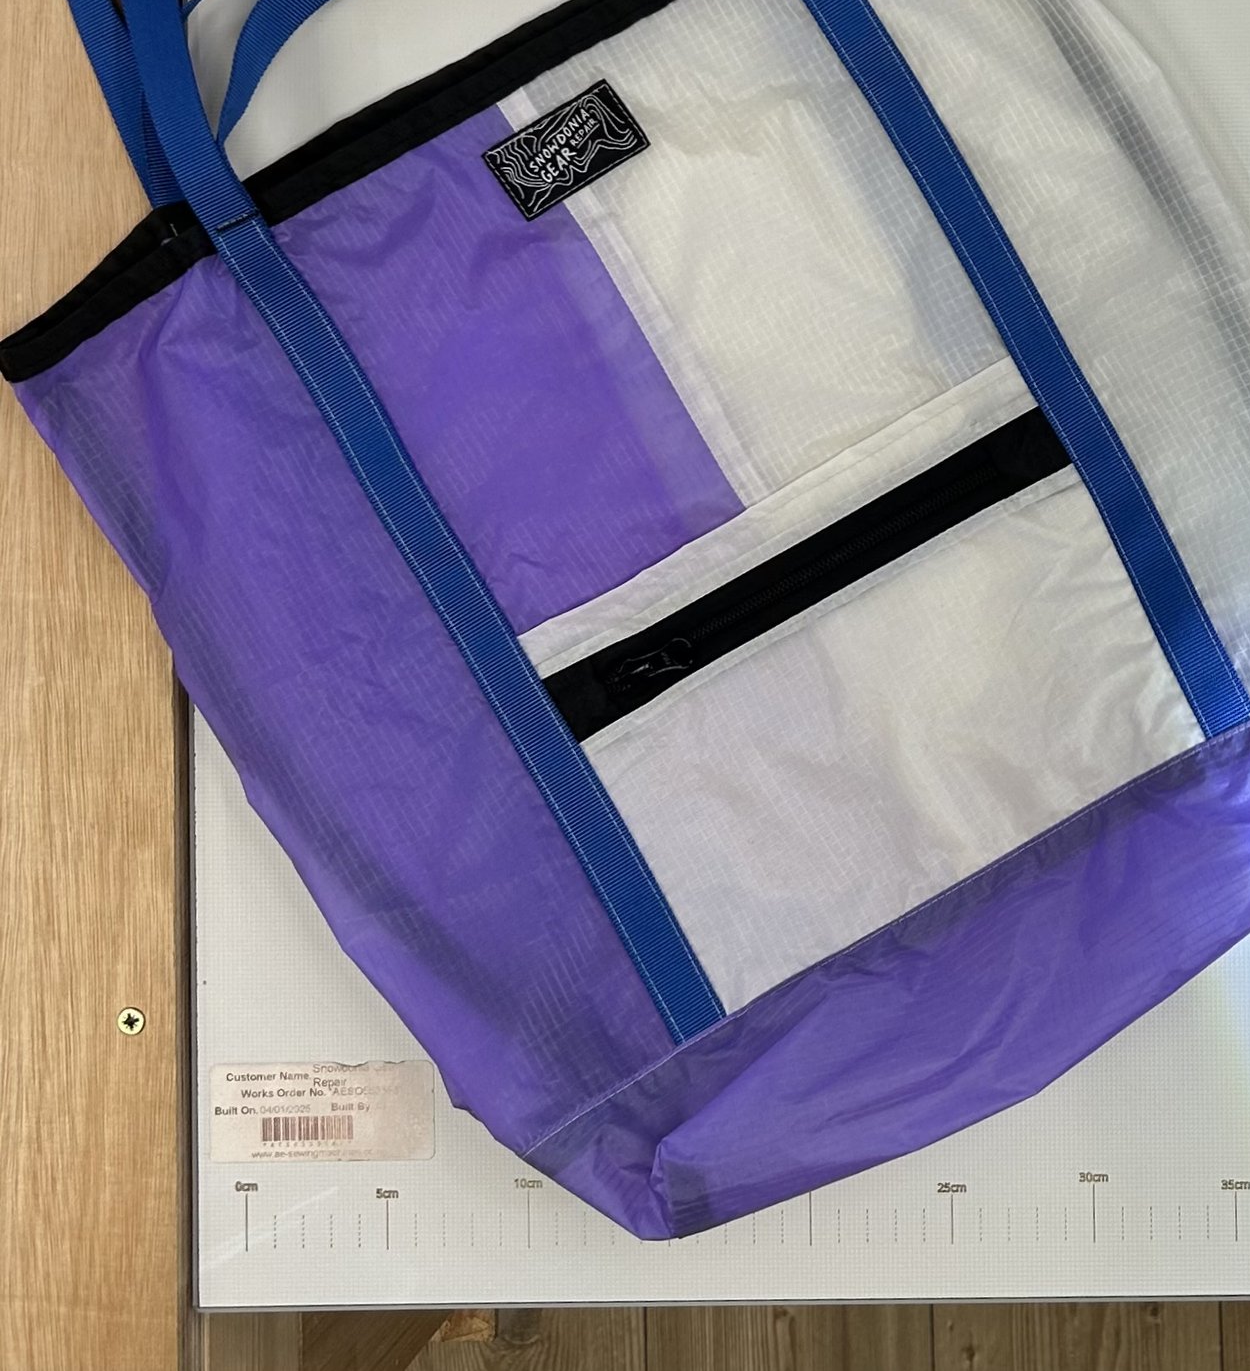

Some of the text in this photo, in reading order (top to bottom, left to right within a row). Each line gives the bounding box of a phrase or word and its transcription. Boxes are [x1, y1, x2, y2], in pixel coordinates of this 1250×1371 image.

[569, 118, 599, 147] REPAIR
[529, 108, 591, 173] SNOWDONIA
[540, 147, 578, 183] GEAR
[226, 1072, 276, 1082] Customer
[313, 1077, 348, 1090] Repair
[241, 1089, 274, 1098] Works
[277, 1088, 306, 1098] Order
[214, 1106, 238, 1115] Built
[331, 1102, 354, 1112] Built
[357, 1102, 370, 1113] By
[1078, 1172, 1109, 1183] 30cm
[235, 1181, 258, 1192] 0cm
[513, 1178, 543, 1189] 10cm
[937, 1182, 967, 1193] 25cm
[1220, 1179, 1250, 1190] 35cm
[376, 1188, 399, 1199] 5cm
